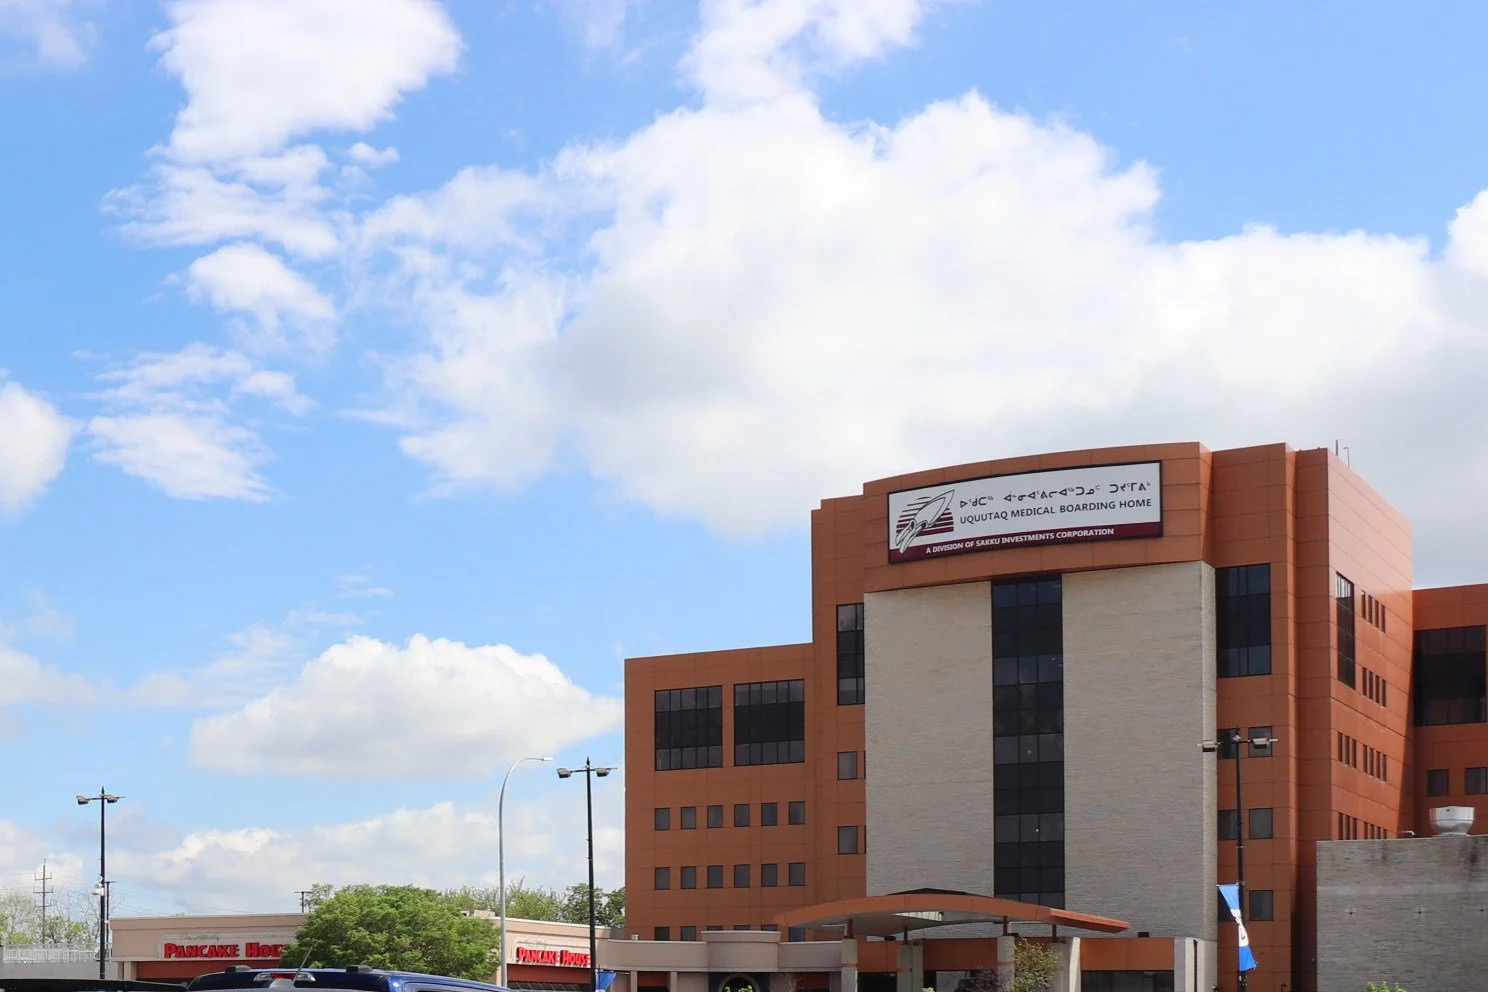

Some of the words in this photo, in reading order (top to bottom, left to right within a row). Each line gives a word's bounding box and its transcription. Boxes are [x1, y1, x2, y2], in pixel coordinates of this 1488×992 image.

[959, 511, 1008, 524] UQUUTAQ
[1010, 506, 1055, 518] MEDICAL
[1059, 501, 1116, 513] BOARDING
[1119, 499, 1152, 509] HOME
[932, 542, 964, 553] DIVISION
[964, 540, 975, 548] OF
[976, 537, 1001, 547] SAKKU
[1001, 533, 1055, 544] INVESTMENTS
[1056, 528, 1114, 539] CORPORATION
[164, 943, 240, 958] PANCAKE
[516, 947, 560, 964] PANCAKE
[560, 950, 591, 966] HOUSE
